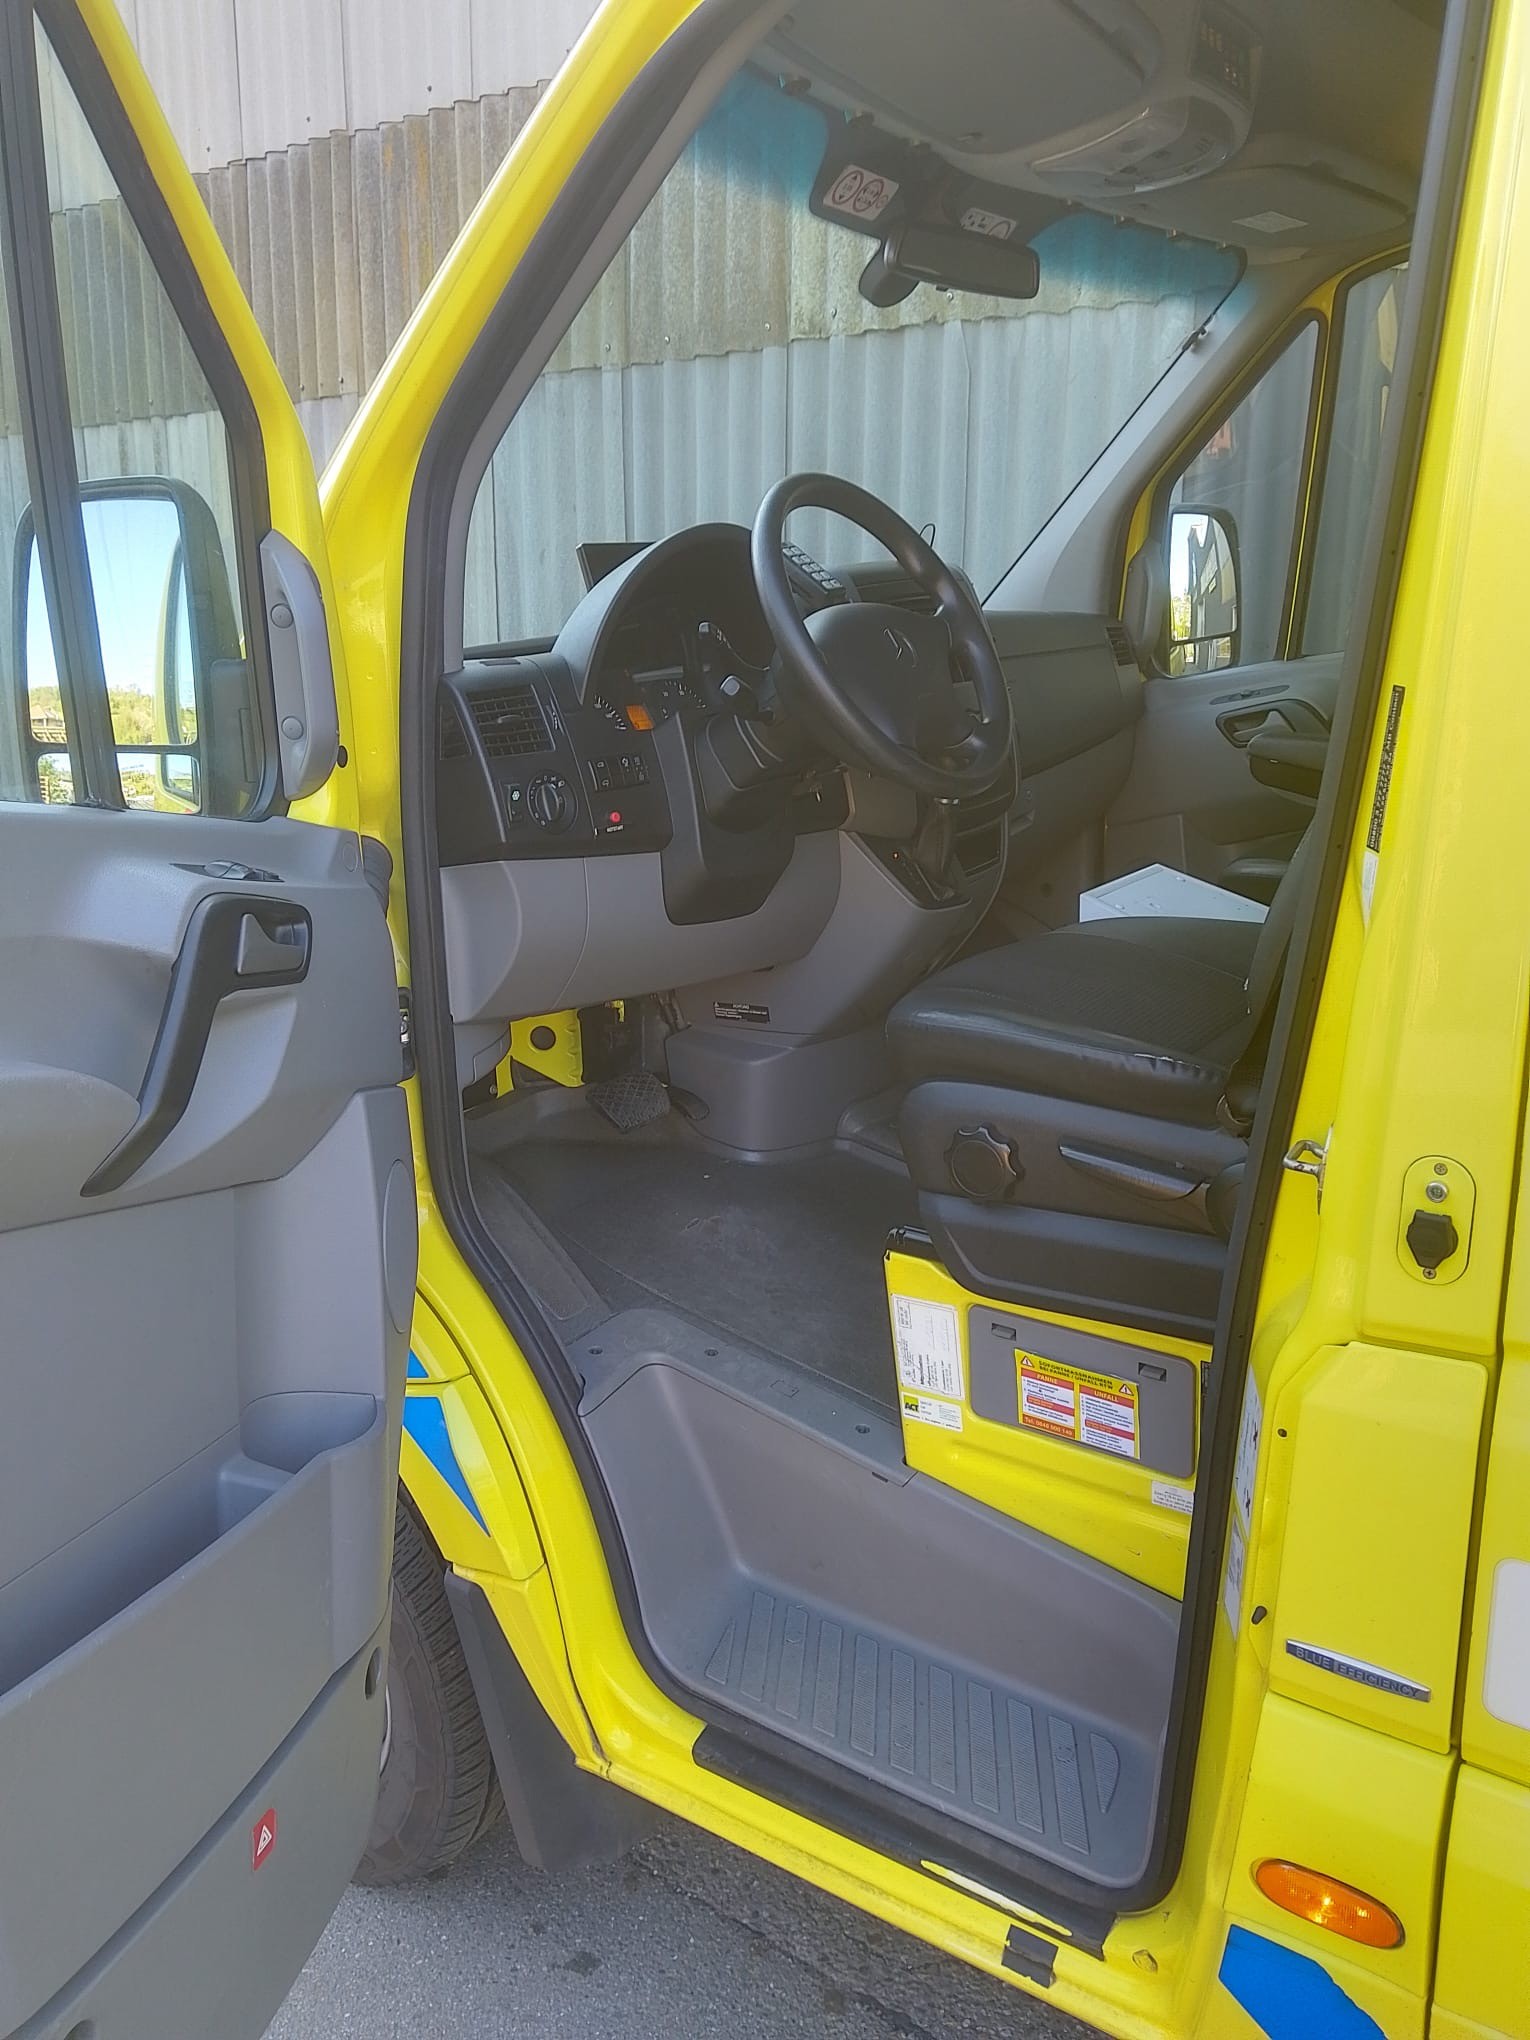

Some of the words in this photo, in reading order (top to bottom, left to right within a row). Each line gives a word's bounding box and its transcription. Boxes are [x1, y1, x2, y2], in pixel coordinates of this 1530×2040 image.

[1094, 1389, 1119, 1403] UNFALL
[1295, 1646, 1332, 1669] BLUE
[1337, 1664, 1419, 1698] EFFICIENCY
